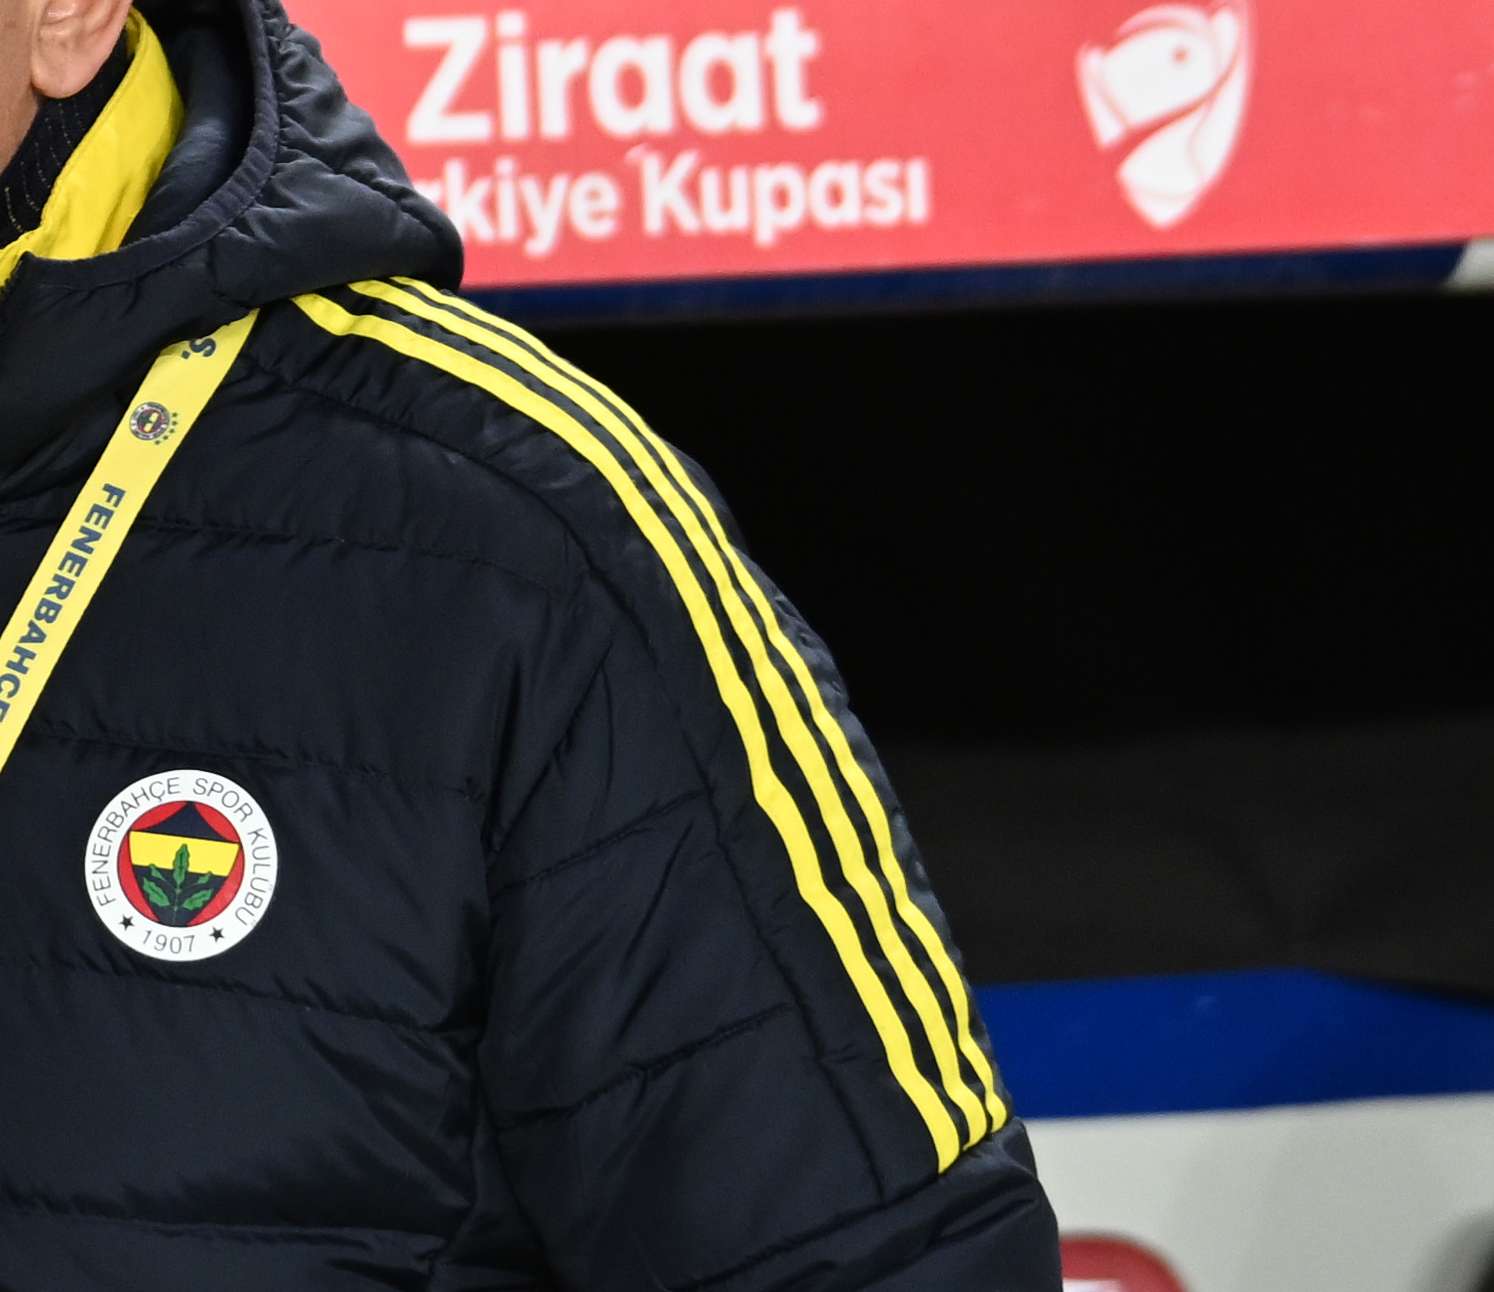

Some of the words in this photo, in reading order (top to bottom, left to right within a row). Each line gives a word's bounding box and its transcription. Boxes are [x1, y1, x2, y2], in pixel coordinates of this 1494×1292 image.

[402, 8, 823, 144] Ziraat
[412, 158, 619, 259] rkiye
[639, 149, 929, 248] Kupası
[92, 776, 181, 907] FENERBAHÇE
[192, 777, 254, 823] SPOR
[142, 929, 196, 954] 1907
